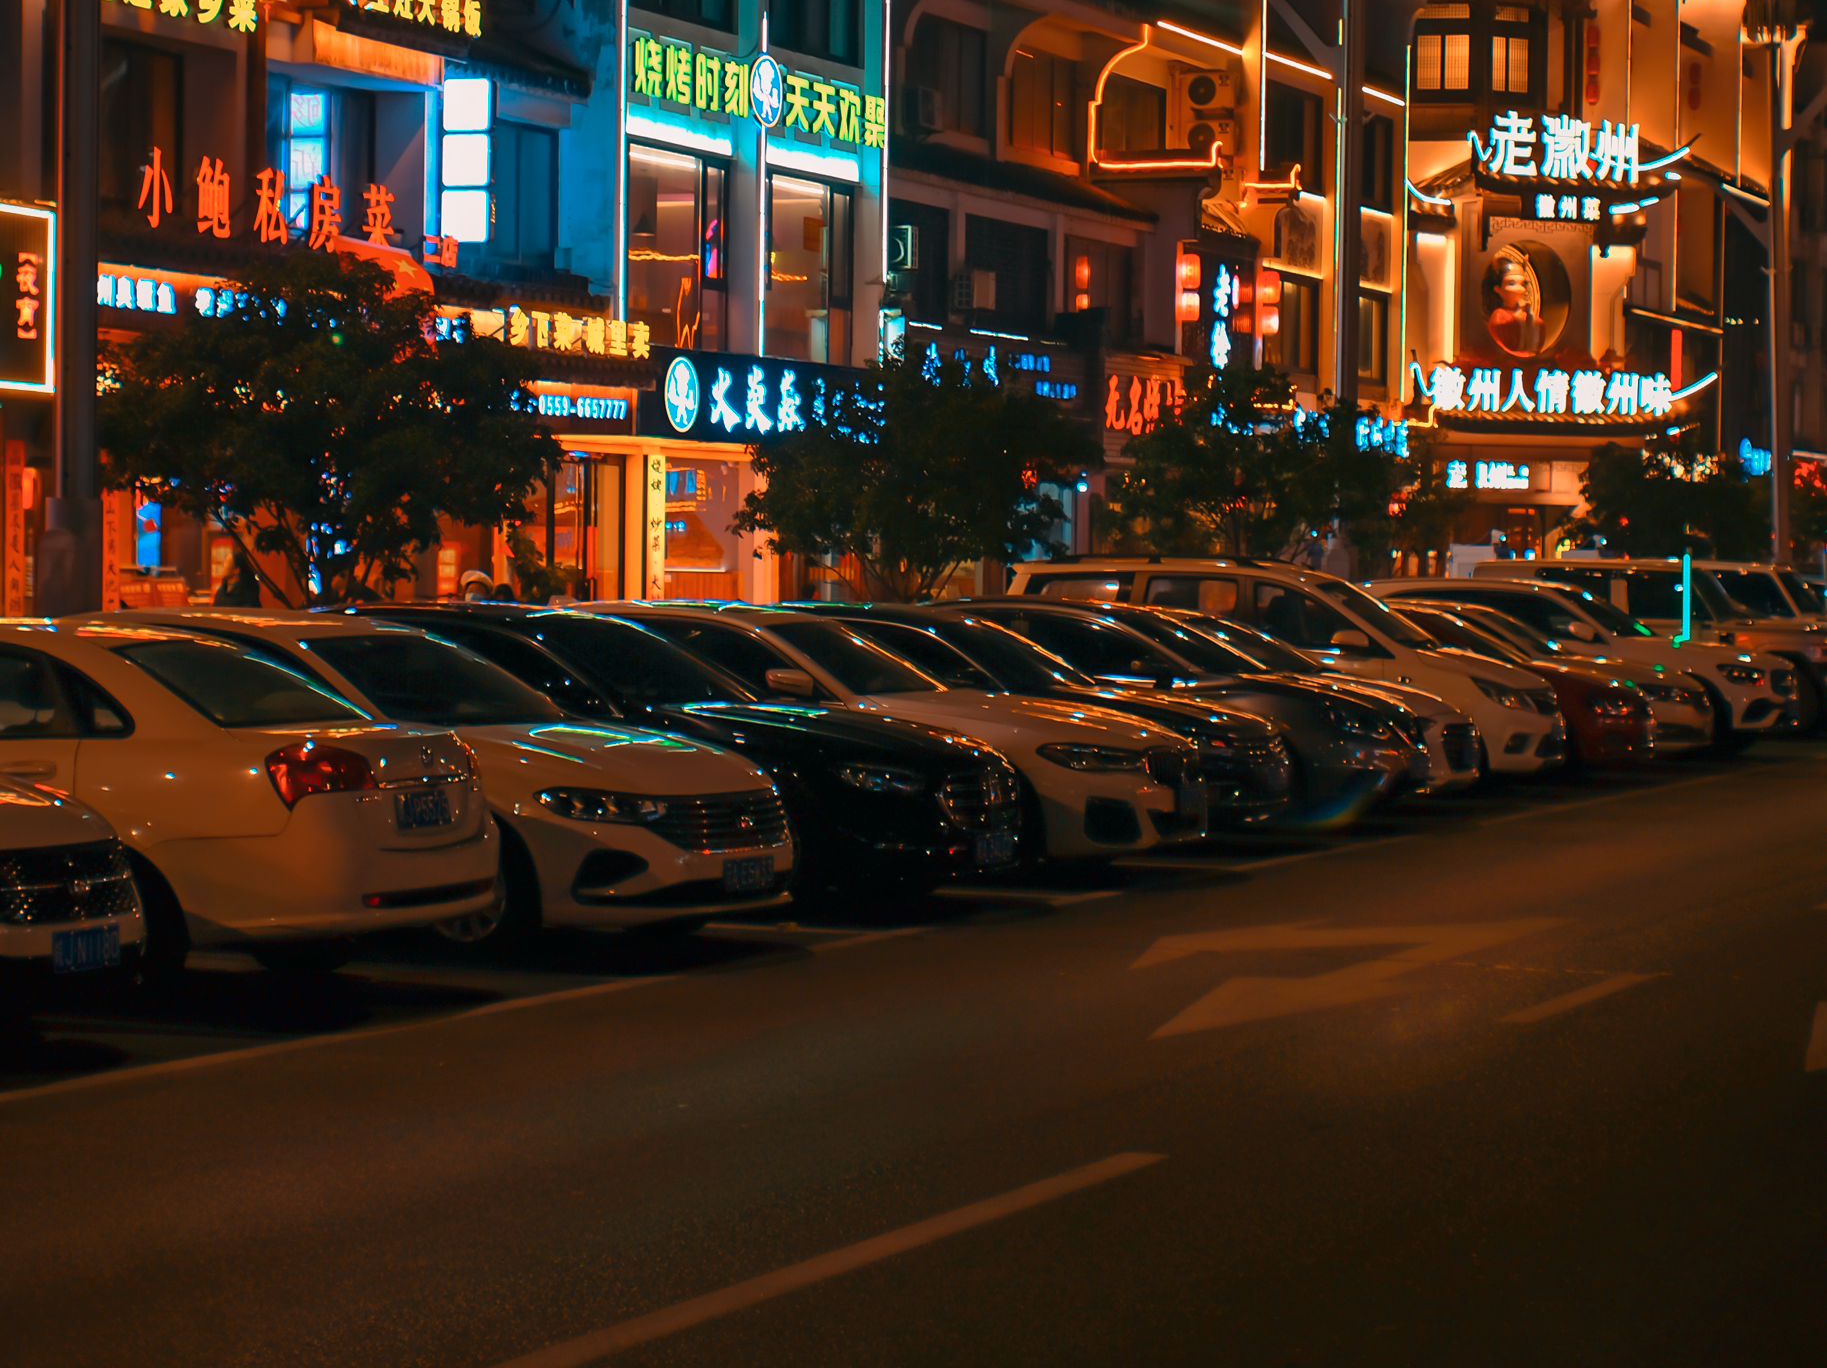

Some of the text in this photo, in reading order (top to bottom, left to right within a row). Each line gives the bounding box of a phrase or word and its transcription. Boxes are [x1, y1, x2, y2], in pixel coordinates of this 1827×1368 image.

[634, 37, 885, 148] 烧烤时刻 天天欢聚
[1488, 110, 1640, 184] 老徽州
[137, 146, 395, 253] 小鲍私房菜
[538, 393, 628, 420] 0559-6657777
[1430, 366, 1674, 416] 徽州人情徽州味
